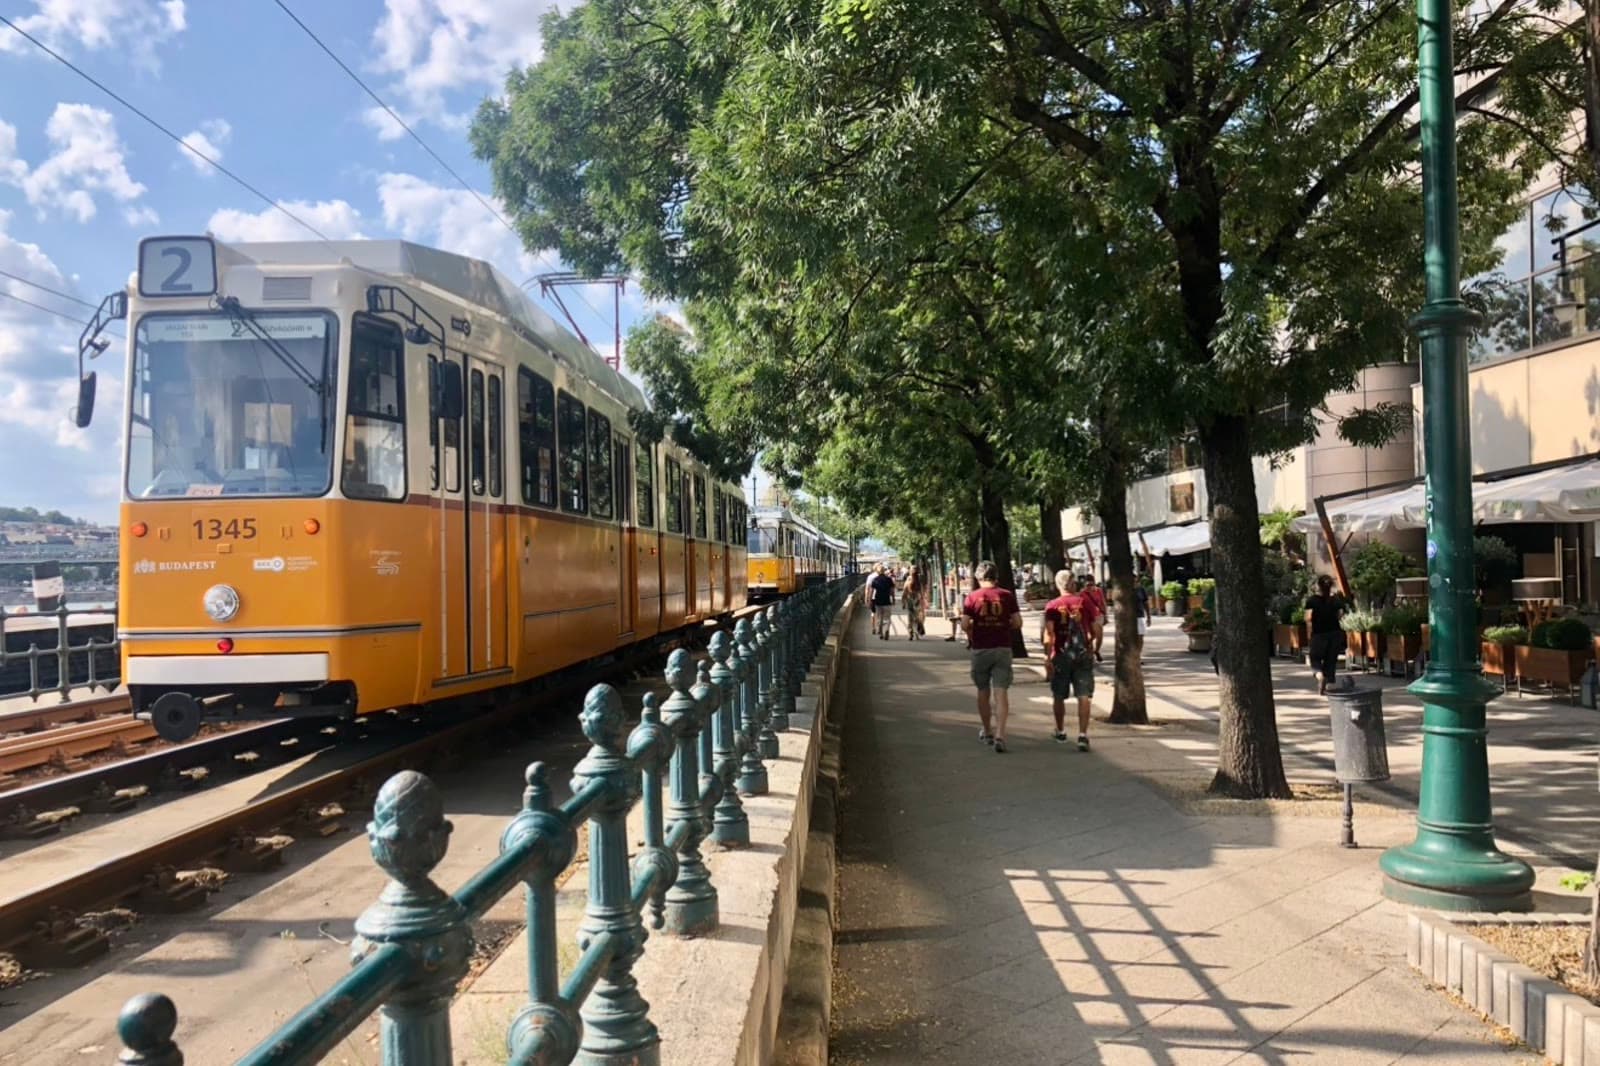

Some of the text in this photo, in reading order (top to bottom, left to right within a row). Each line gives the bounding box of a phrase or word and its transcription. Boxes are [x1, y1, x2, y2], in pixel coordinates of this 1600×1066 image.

[161, 246, 193, 291] 2
[231, 321, 241, 337] 2
[193, 518, 257, 540] 1345
[159, 560, 216, 571] BUDAPEST
